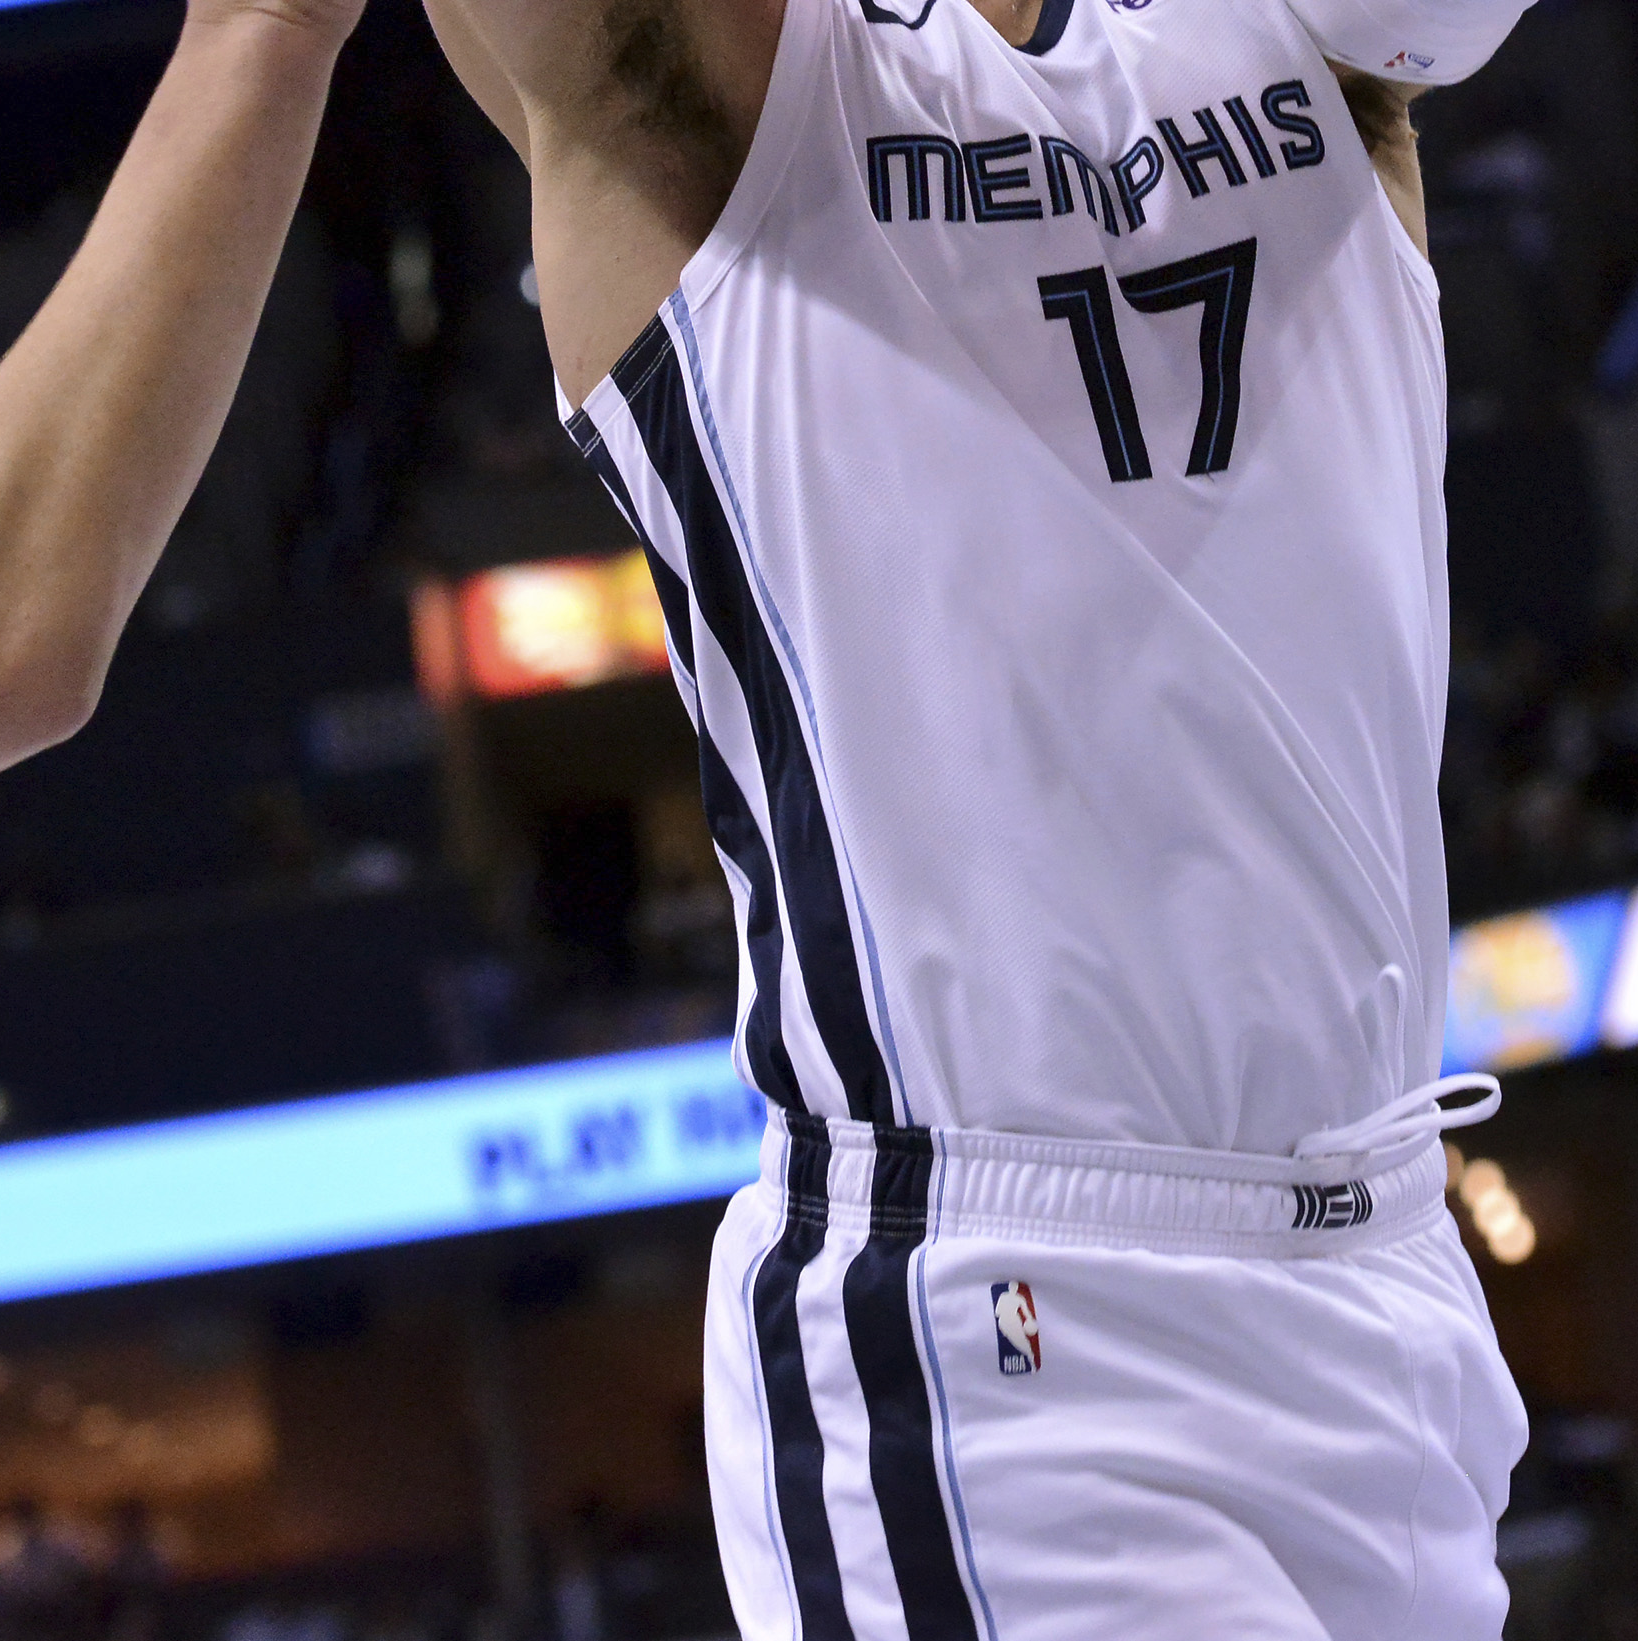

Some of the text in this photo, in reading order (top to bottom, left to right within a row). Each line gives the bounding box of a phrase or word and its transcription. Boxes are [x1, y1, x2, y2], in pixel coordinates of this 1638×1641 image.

[865, 79, 1326, 238] MEMPHIS
[1036, 236, 1258, 484] 17
[1003, 1354, 1028, 1373] NBA
